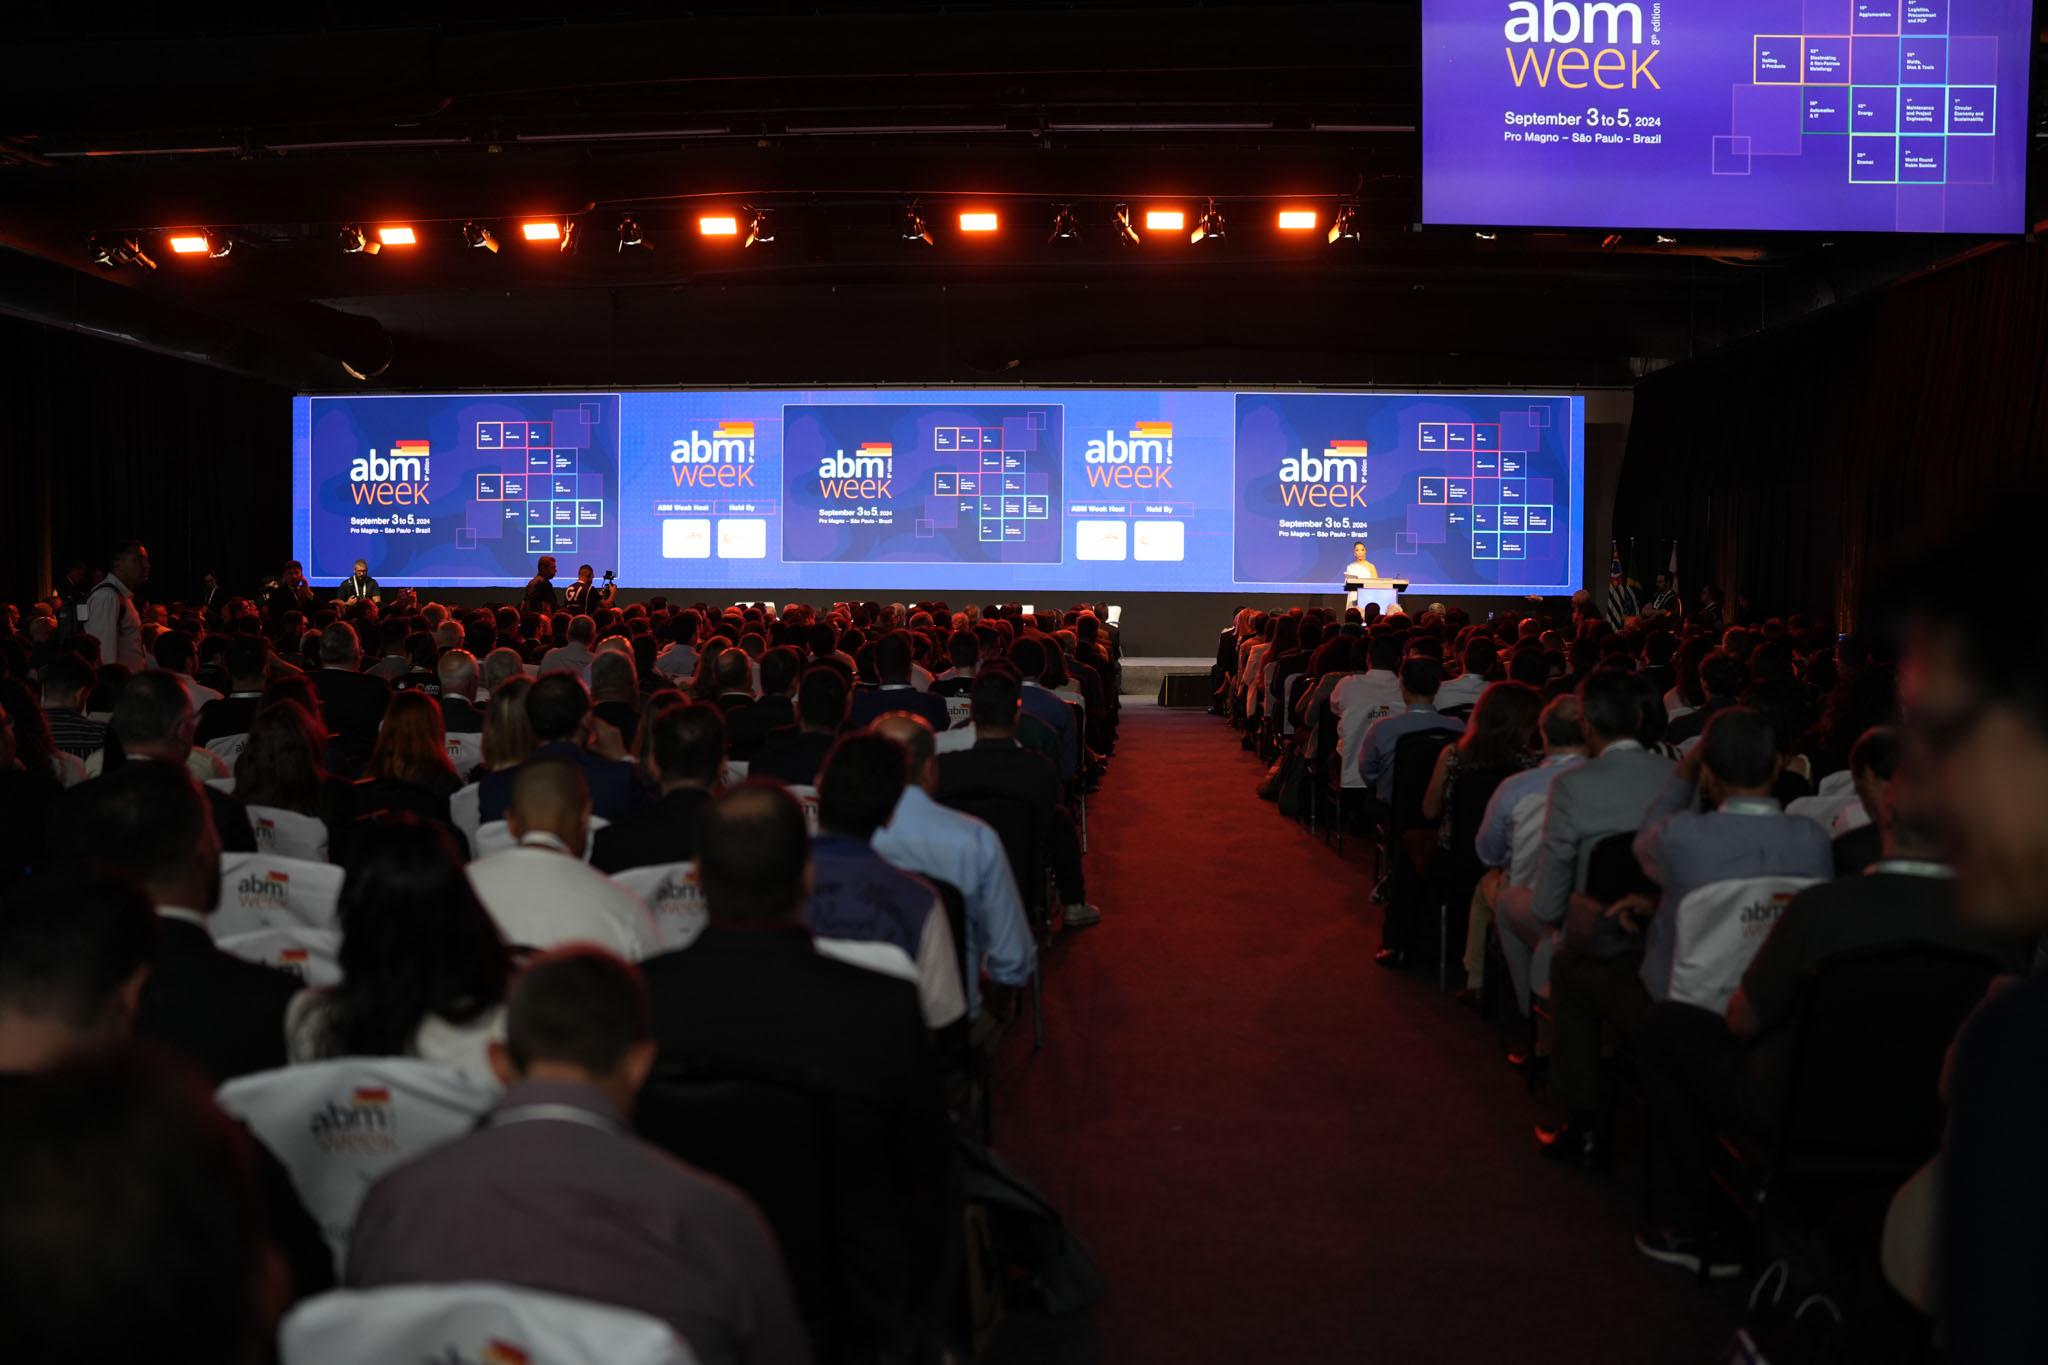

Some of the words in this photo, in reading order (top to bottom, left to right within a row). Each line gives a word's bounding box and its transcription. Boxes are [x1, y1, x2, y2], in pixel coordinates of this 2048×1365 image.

[1504, 0, 1642, 43] abm
[1651, 3, 1660, 32] edition
[1505, 48, 1661, 89] week
[1505, 111, 1582, 127] September
[1586, 108, 1599, 126] 3
[1601, 113, 1615, 126] to
[1635, 117, 1661, 127] 2024
[1504, 132, 1521, 141] Pro
[1525, 132, 1559, 144] Magno
[1572, 132, 1592, 143] São
[1595, 133, 1623, 143] Paulo
[1633, 134, 1661, 144] Brazil
[670, 430, 744, 464] abm
[1085, 430, 1163, 464] abm
[350, 449, 420, 481] abm
[671, 464, 755, 488] week
[819, 450, 884, 478] abm
[1279, 448, 1357, 482] abm
[820, 479, 892, 499] week
[1086, 465, 1173, 489] week
[351, 482, 430, 505] week
[1280, 484, 1367, 508] week
[350, 516, 390, 526] September
[392, 514, 399, 524] 3
[400, 516, 406, 524] to
[819, 509, 855, 517] September
[857, 507, 864, 516] 3
[1146, 505, 1162, 513] Held
[1279, 519, 1322, 529] September
[1325, 517, 1333, 528] 3
[1334, 519, 1341, 528] to
[1290, 530, 1310, 538] Magno
[239, 873, 284, 896] abm
[311, 1100, 388, 1136] abm
